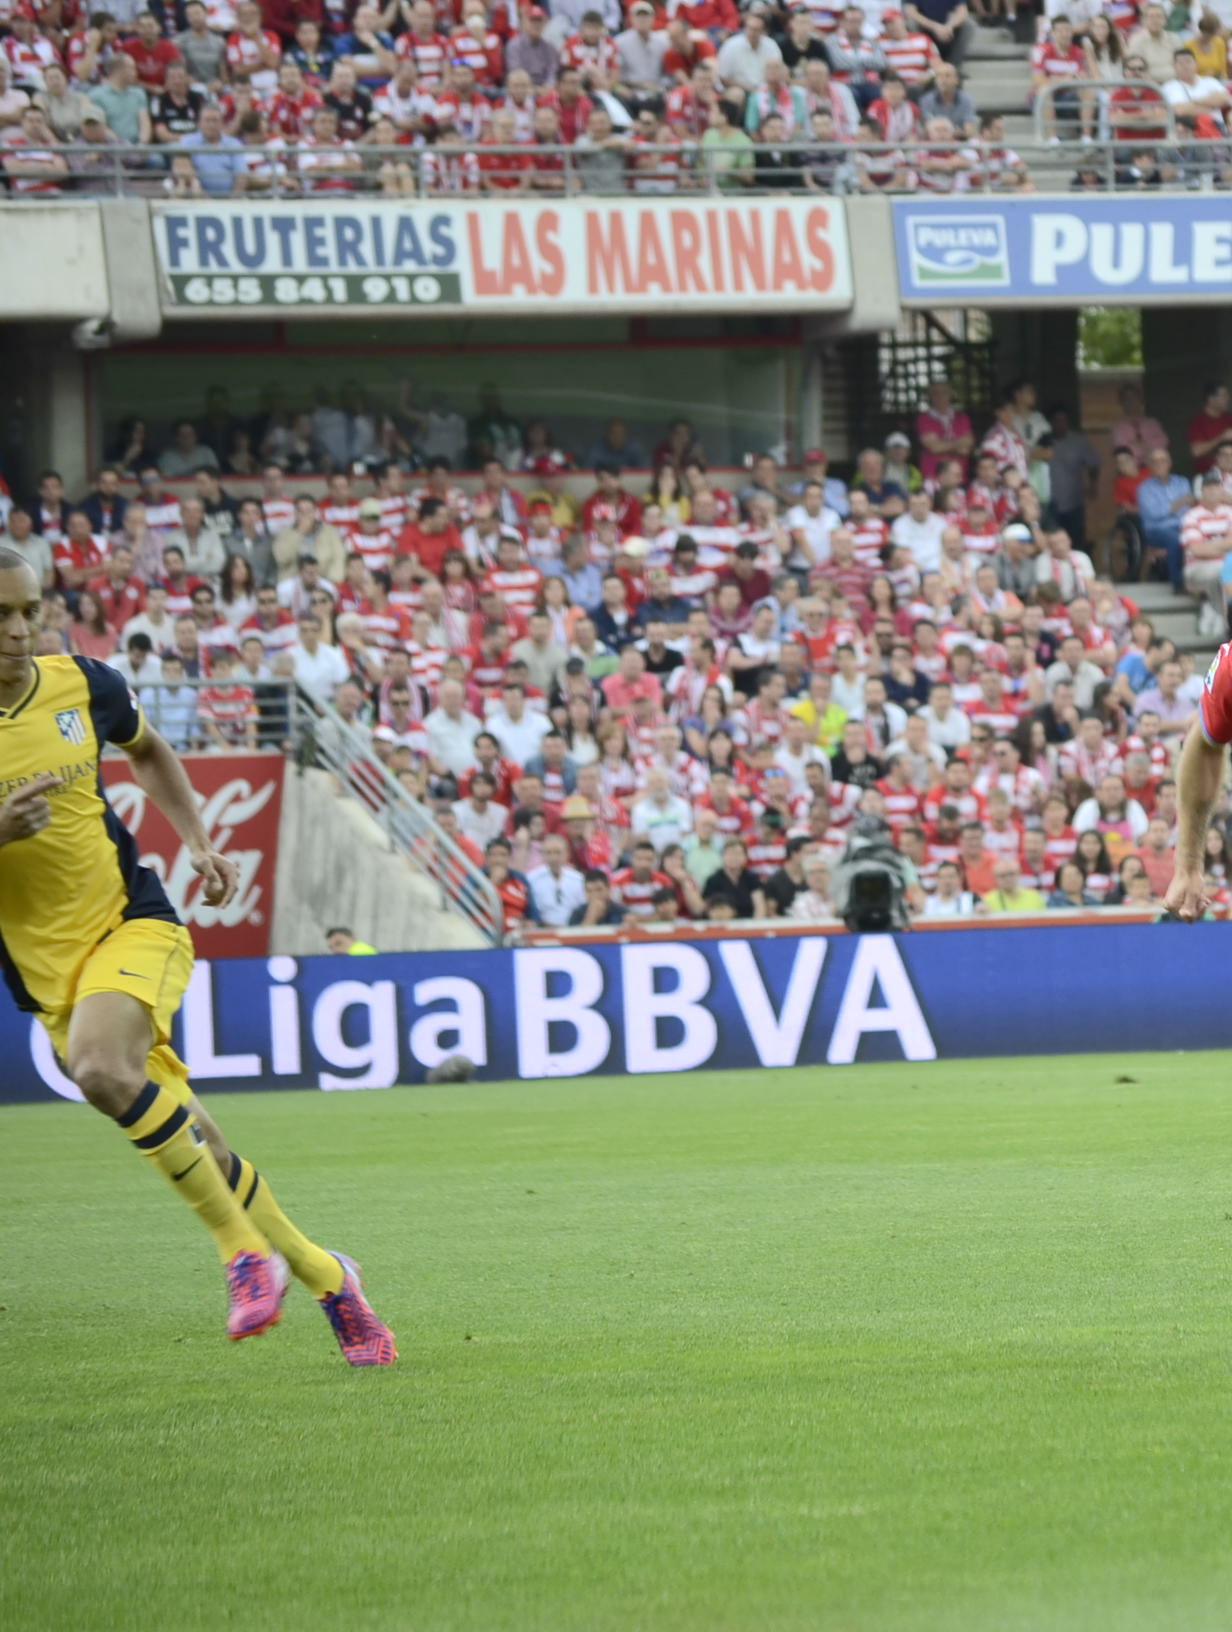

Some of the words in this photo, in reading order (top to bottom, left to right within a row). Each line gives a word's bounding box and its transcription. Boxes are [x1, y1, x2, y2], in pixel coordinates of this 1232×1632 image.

[164, 213, 457, 270] FRUTERIAS
[466, 208, 566, 297] LAS
[585, 205, 835, 296] MARINAS
[184, 276, 263, 304] 655
[274, 276, 348, 303] 841
[361, 275, 442, 303] 910
[182, 955, 488, 1092] Liga
[513, 933, 937, 1079] BBVA
